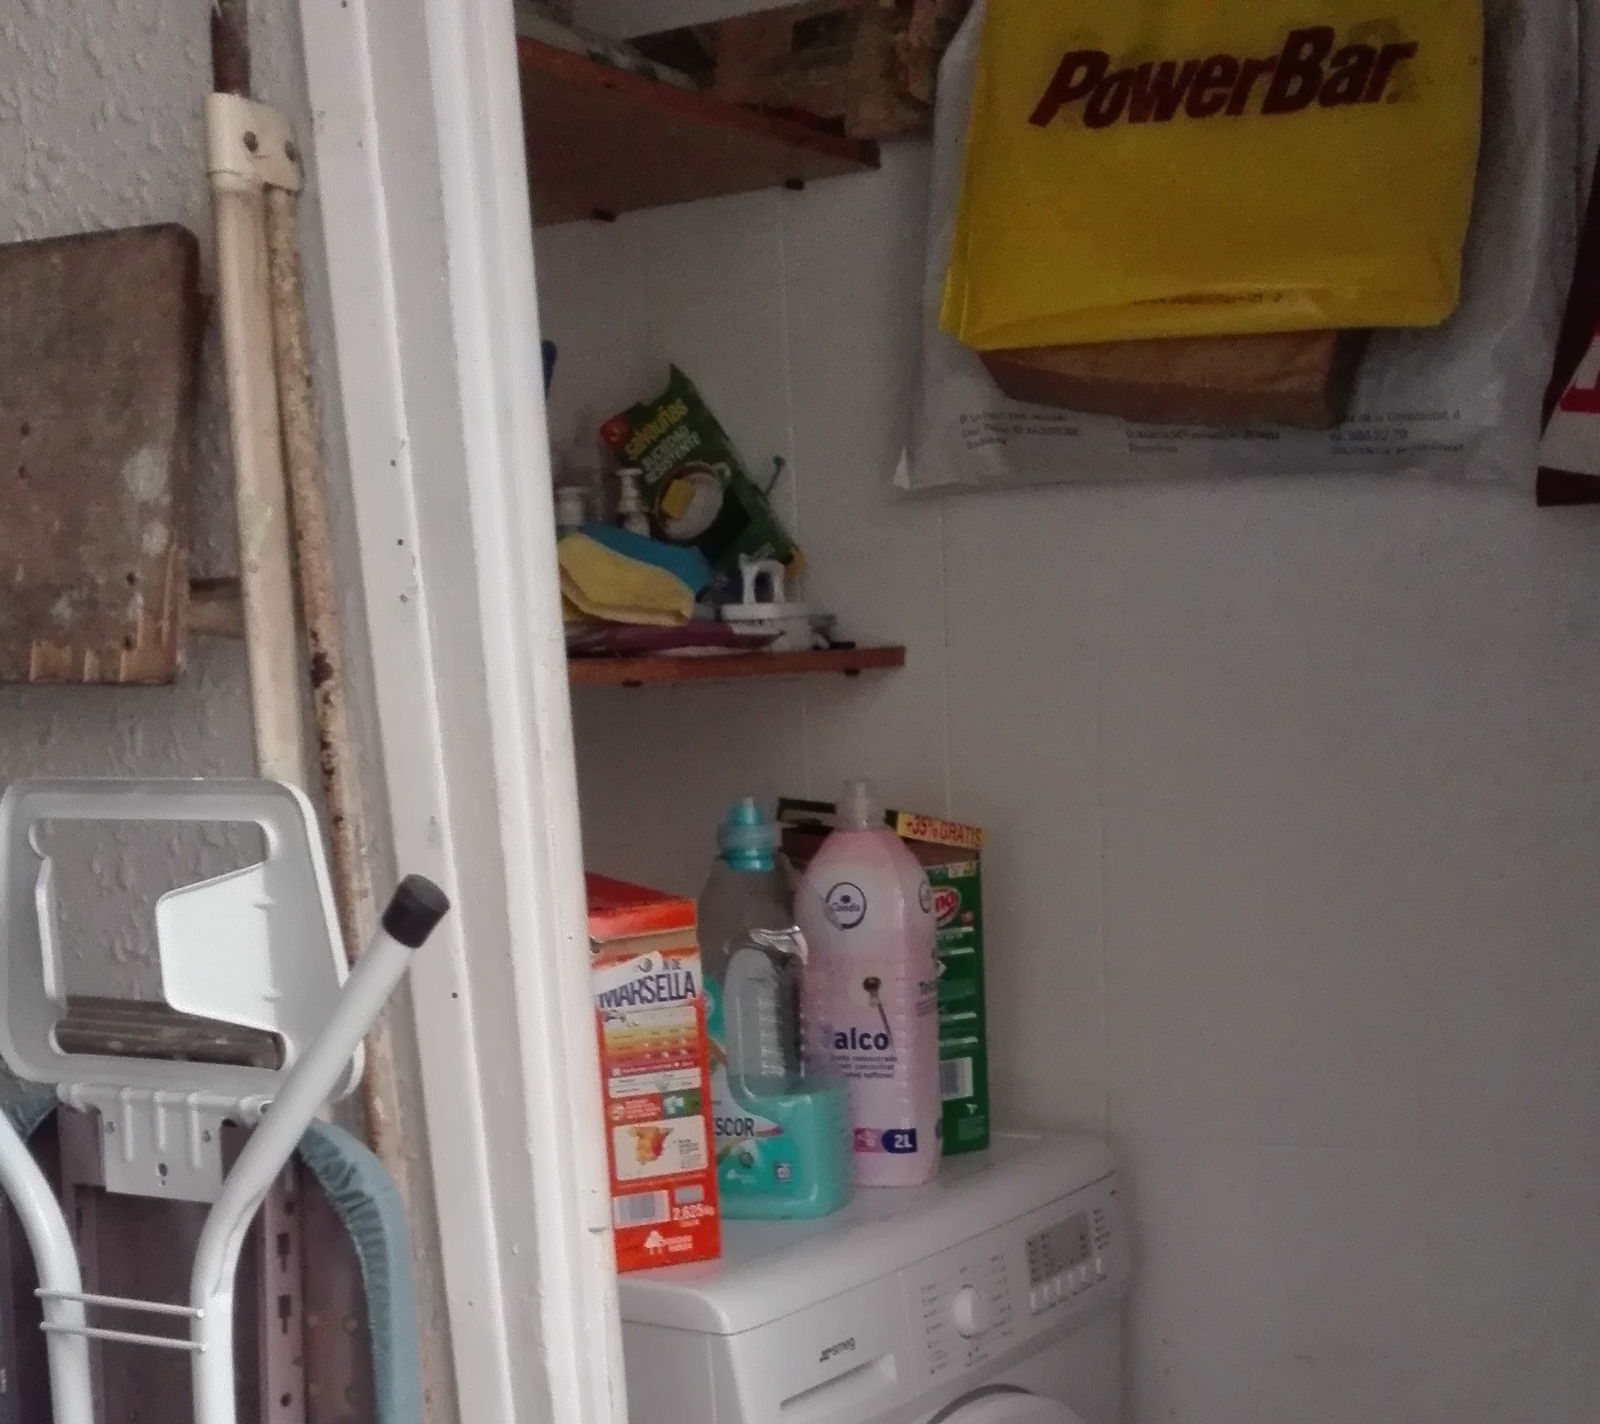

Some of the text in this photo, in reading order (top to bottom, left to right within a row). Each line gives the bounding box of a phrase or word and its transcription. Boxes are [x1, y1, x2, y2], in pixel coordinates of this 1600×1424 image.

[1027, 25, 1419, 129] PowerBar
[599, 970, 697, 1009] MARSELLA
[834, 1026, 889, 1051] alco
[710, 1117, 755, 1138] SCOR
[894, 1133, 913, 1149] 2L
